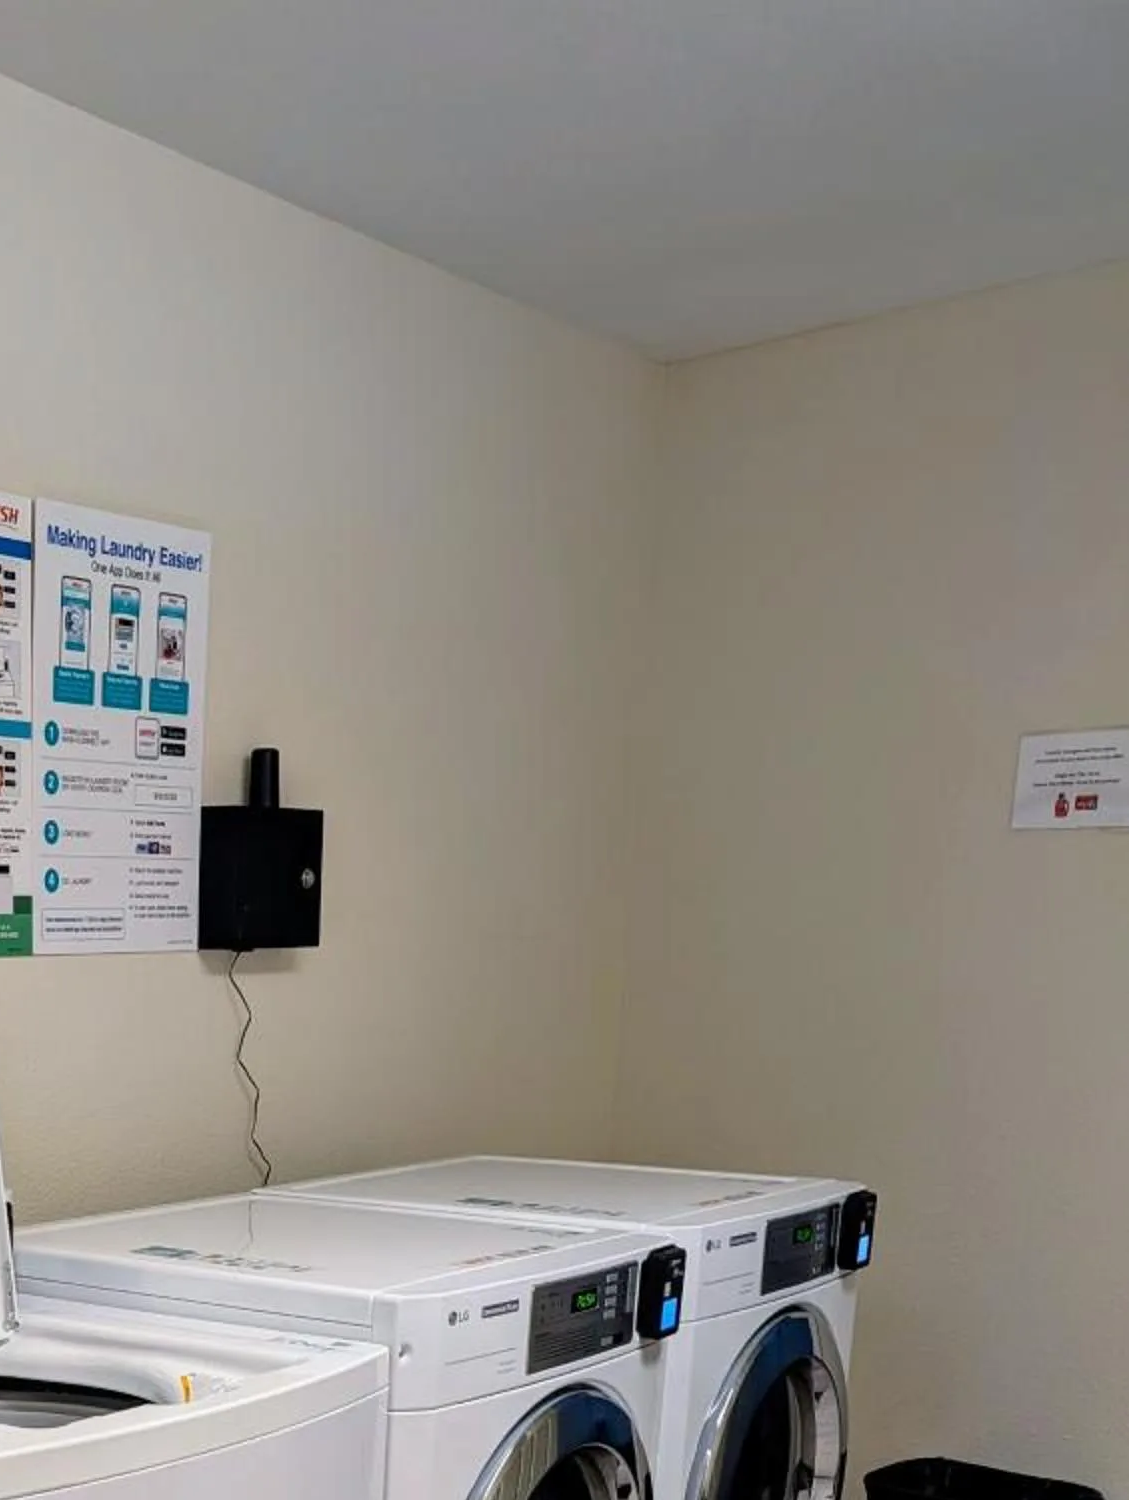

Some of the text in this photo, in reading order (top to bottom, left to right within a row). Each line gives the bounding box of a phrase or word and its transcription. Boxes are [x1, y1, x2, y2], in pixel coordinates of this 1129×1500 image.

[47, 524, 203, 573] Making Laundry Easier!
[91, 560, 108, 574] One
[109, 564, 123, 578] App
[125, 566, 144, 580] Does
